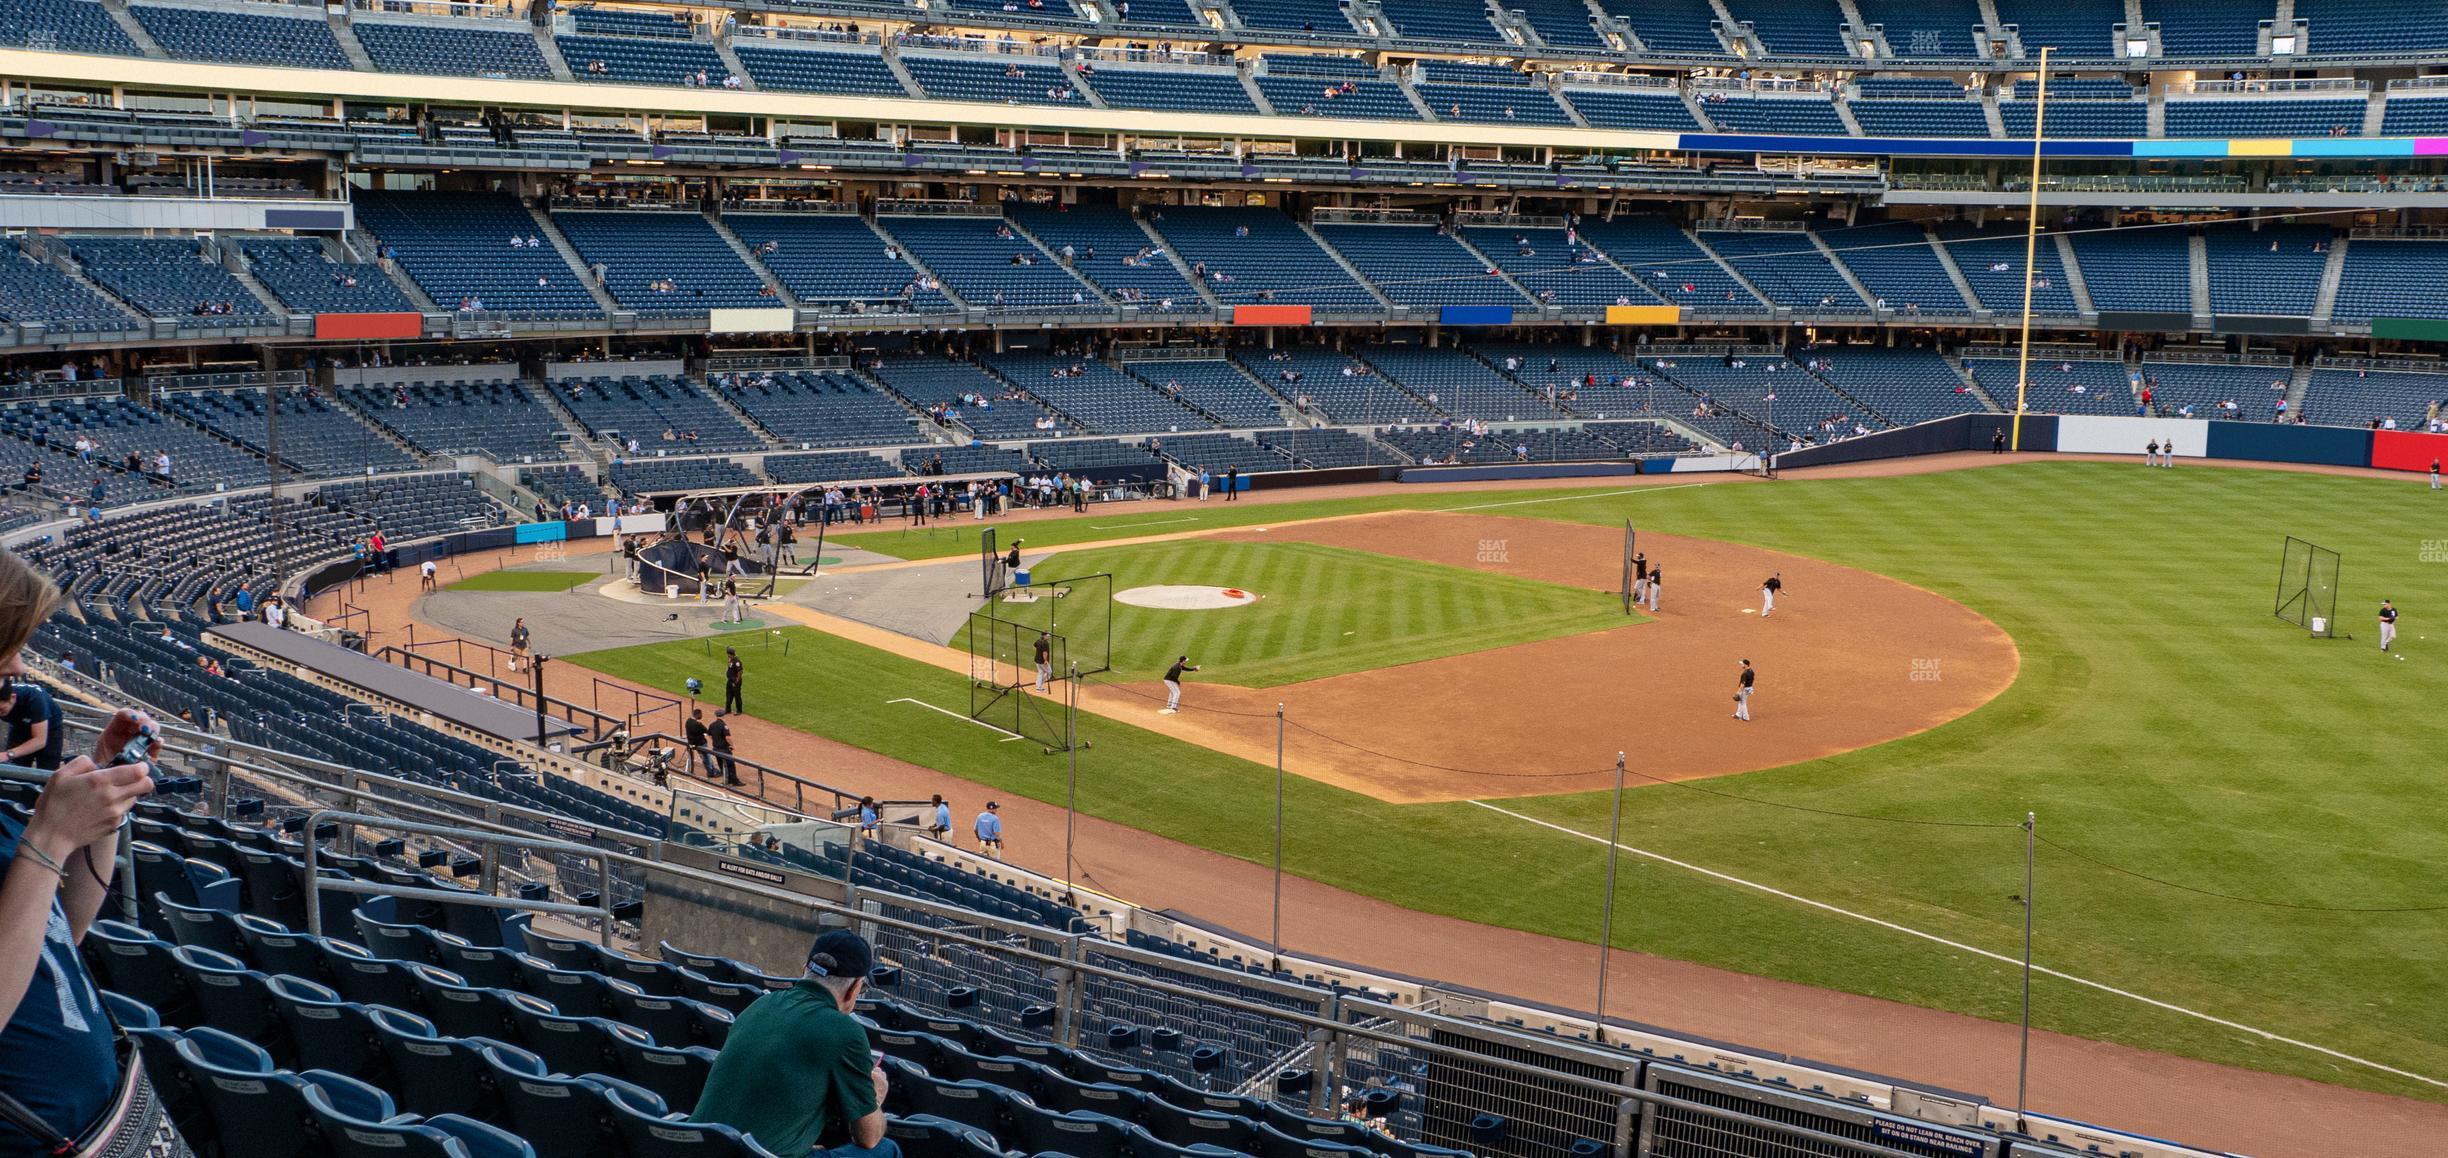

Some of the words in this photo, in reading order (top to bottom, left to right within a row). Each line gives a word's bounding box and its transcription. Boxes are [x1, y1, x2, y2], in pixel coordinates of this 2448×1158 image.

[1875, 1119, 1896, 1129] PLEASE
[1918, 1128, 1933, 1137] LEAN
[1945, 1134, 1965, 1144] REACH
[1909, 1134, 1928, 1142] STAND
[1929, 1138, 1945, 1147] NEAR
